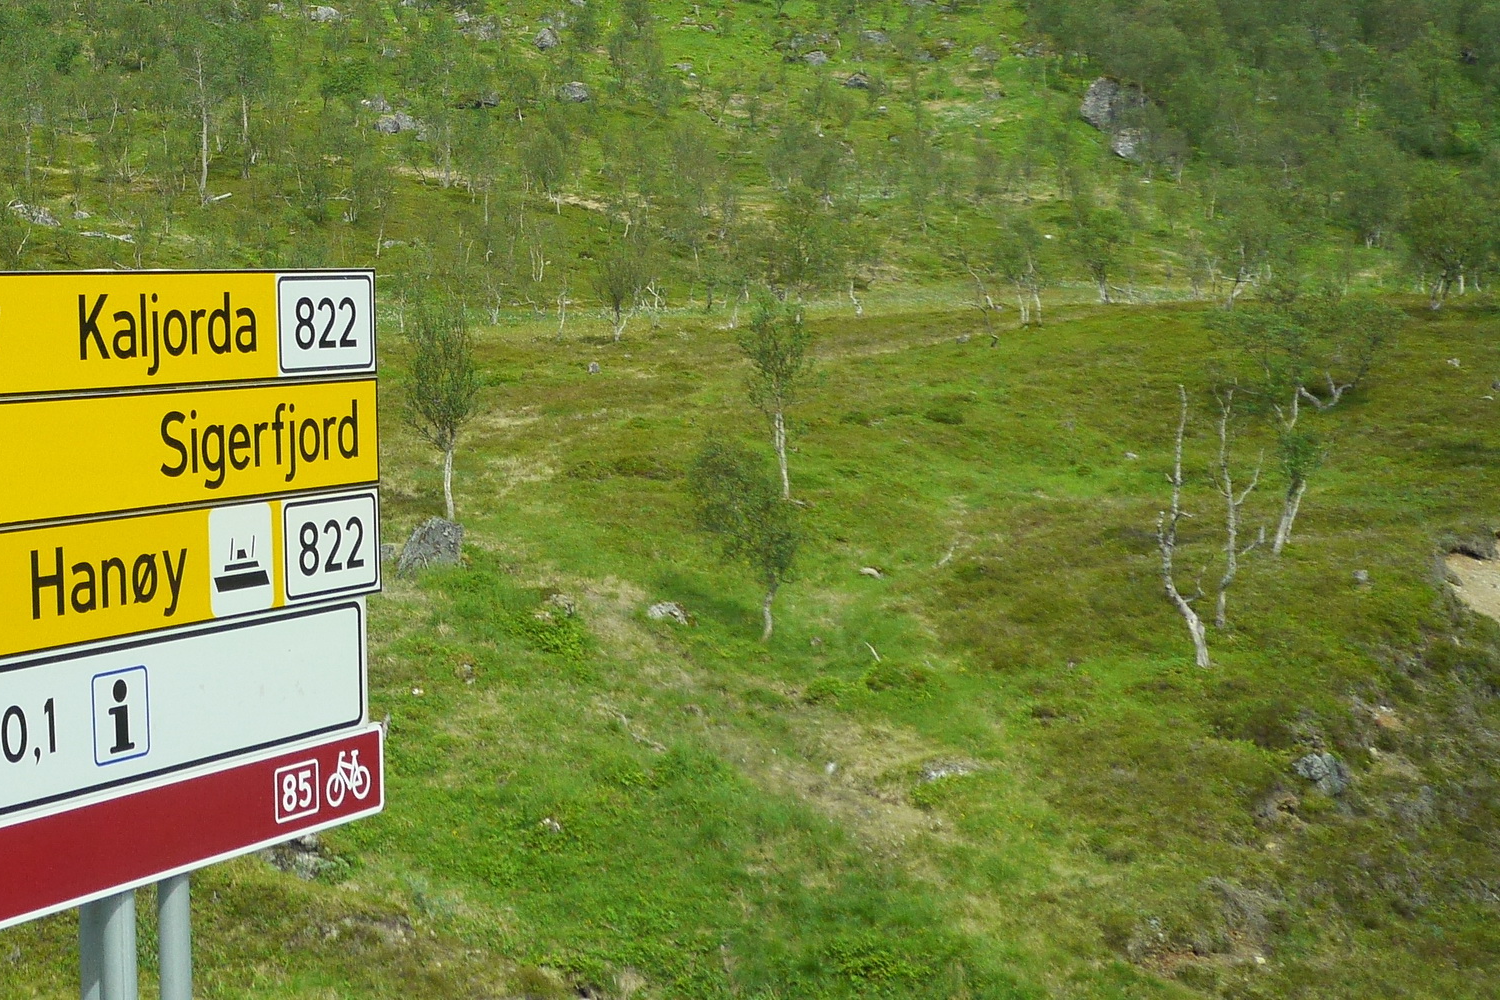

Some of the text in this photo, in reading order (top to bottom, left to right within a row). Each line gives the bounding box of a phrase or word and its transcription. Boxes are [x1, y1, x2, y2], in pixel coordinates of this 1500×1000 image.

[78, 292, 258, 376] Kaljorda
[294, 296, 358, 350] 822
[160, 399, 359, 490] Sigerfjord
[30, 516, 365, 620] Hanøy 822
[1, 697, 57, 765] 0,1
[282, 769, 313, 813] 85
